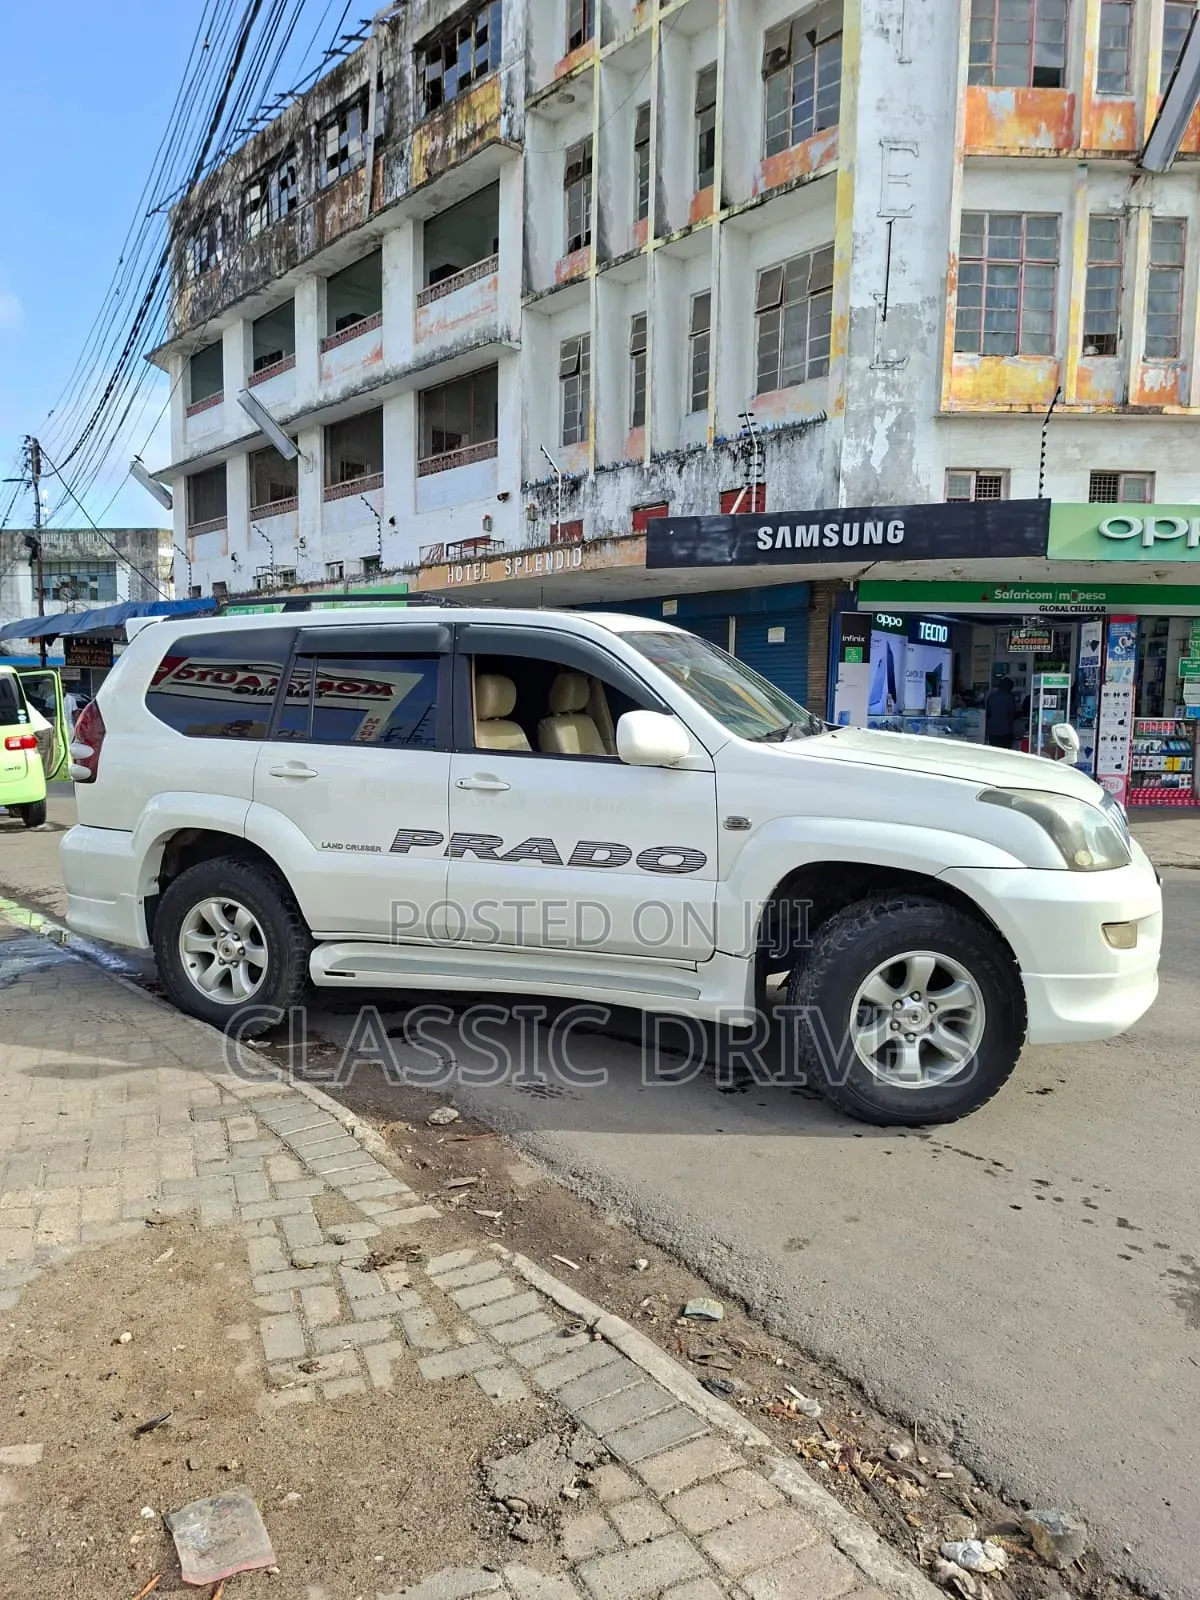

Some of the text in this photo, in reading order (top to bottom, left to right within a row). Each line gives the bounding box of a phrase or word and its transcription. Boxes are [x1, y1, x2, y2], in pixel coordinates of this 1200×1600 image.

[757, 519, 905, 551] SAMSUNG
[1098, 515, 1200, 548] op
[447, 547, 582, 584] HOTEL SPLENDID
[994, 589, 1053, 600] Safaricom
[1039, 604, 1106, 613] GLOBAL CELLULAR
[876, 613, 903, 628] oppo
[842, 634, 865, 642] Infinix
[919, 621, 948, 643] TECNO
[321, 828, 708, 874] LAND CRUISER PRADO
